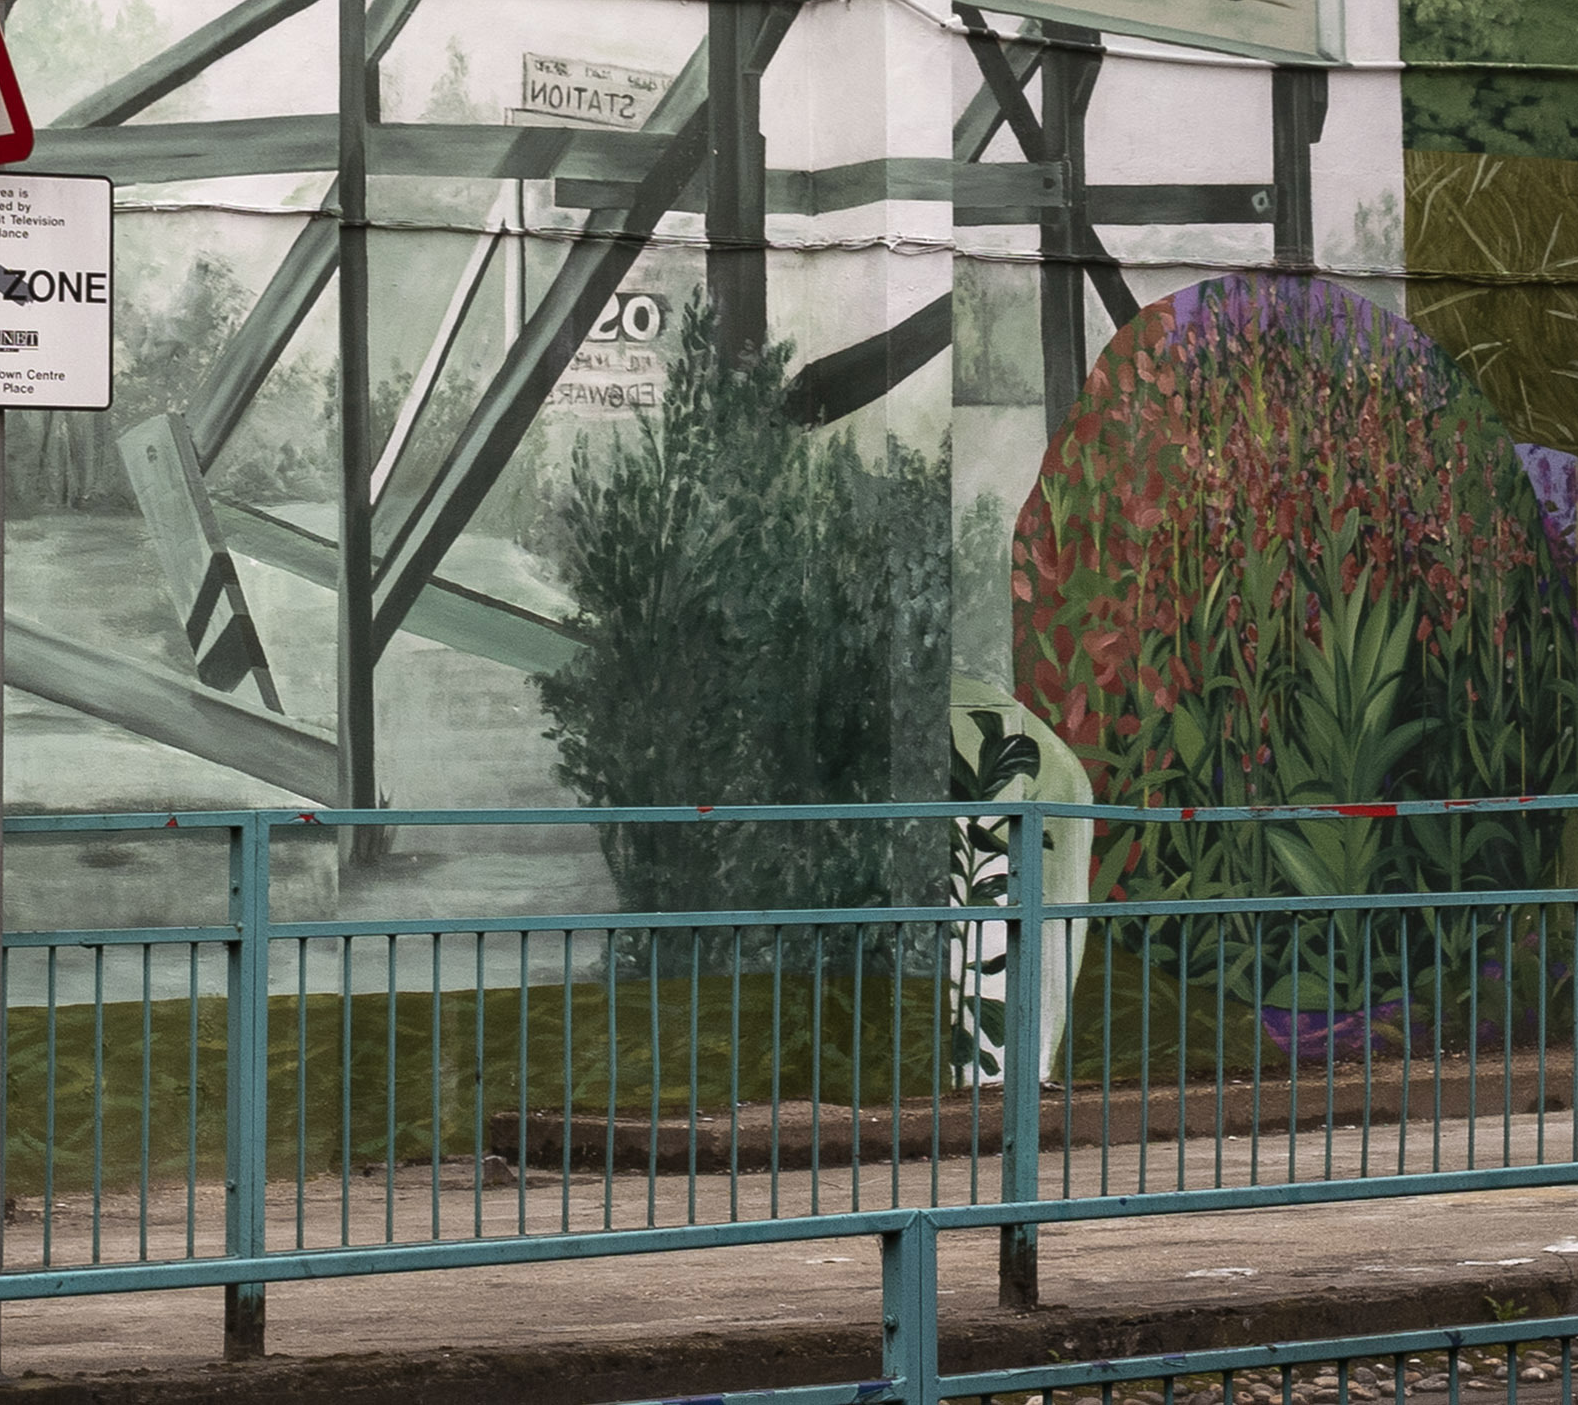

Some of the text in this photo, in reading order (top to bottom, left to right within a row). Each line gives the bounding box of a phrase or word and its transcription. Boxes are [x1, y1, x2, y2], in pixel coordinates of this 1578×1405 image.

[19, 188, 29, 198] is
[17, 202, 31, 214] by
[10, 214, 65, 227] Television
[3, 270, 107, 304] ZONE
[27, 369, 66, 381] Centre
[3, 383, 34, 393] Place
